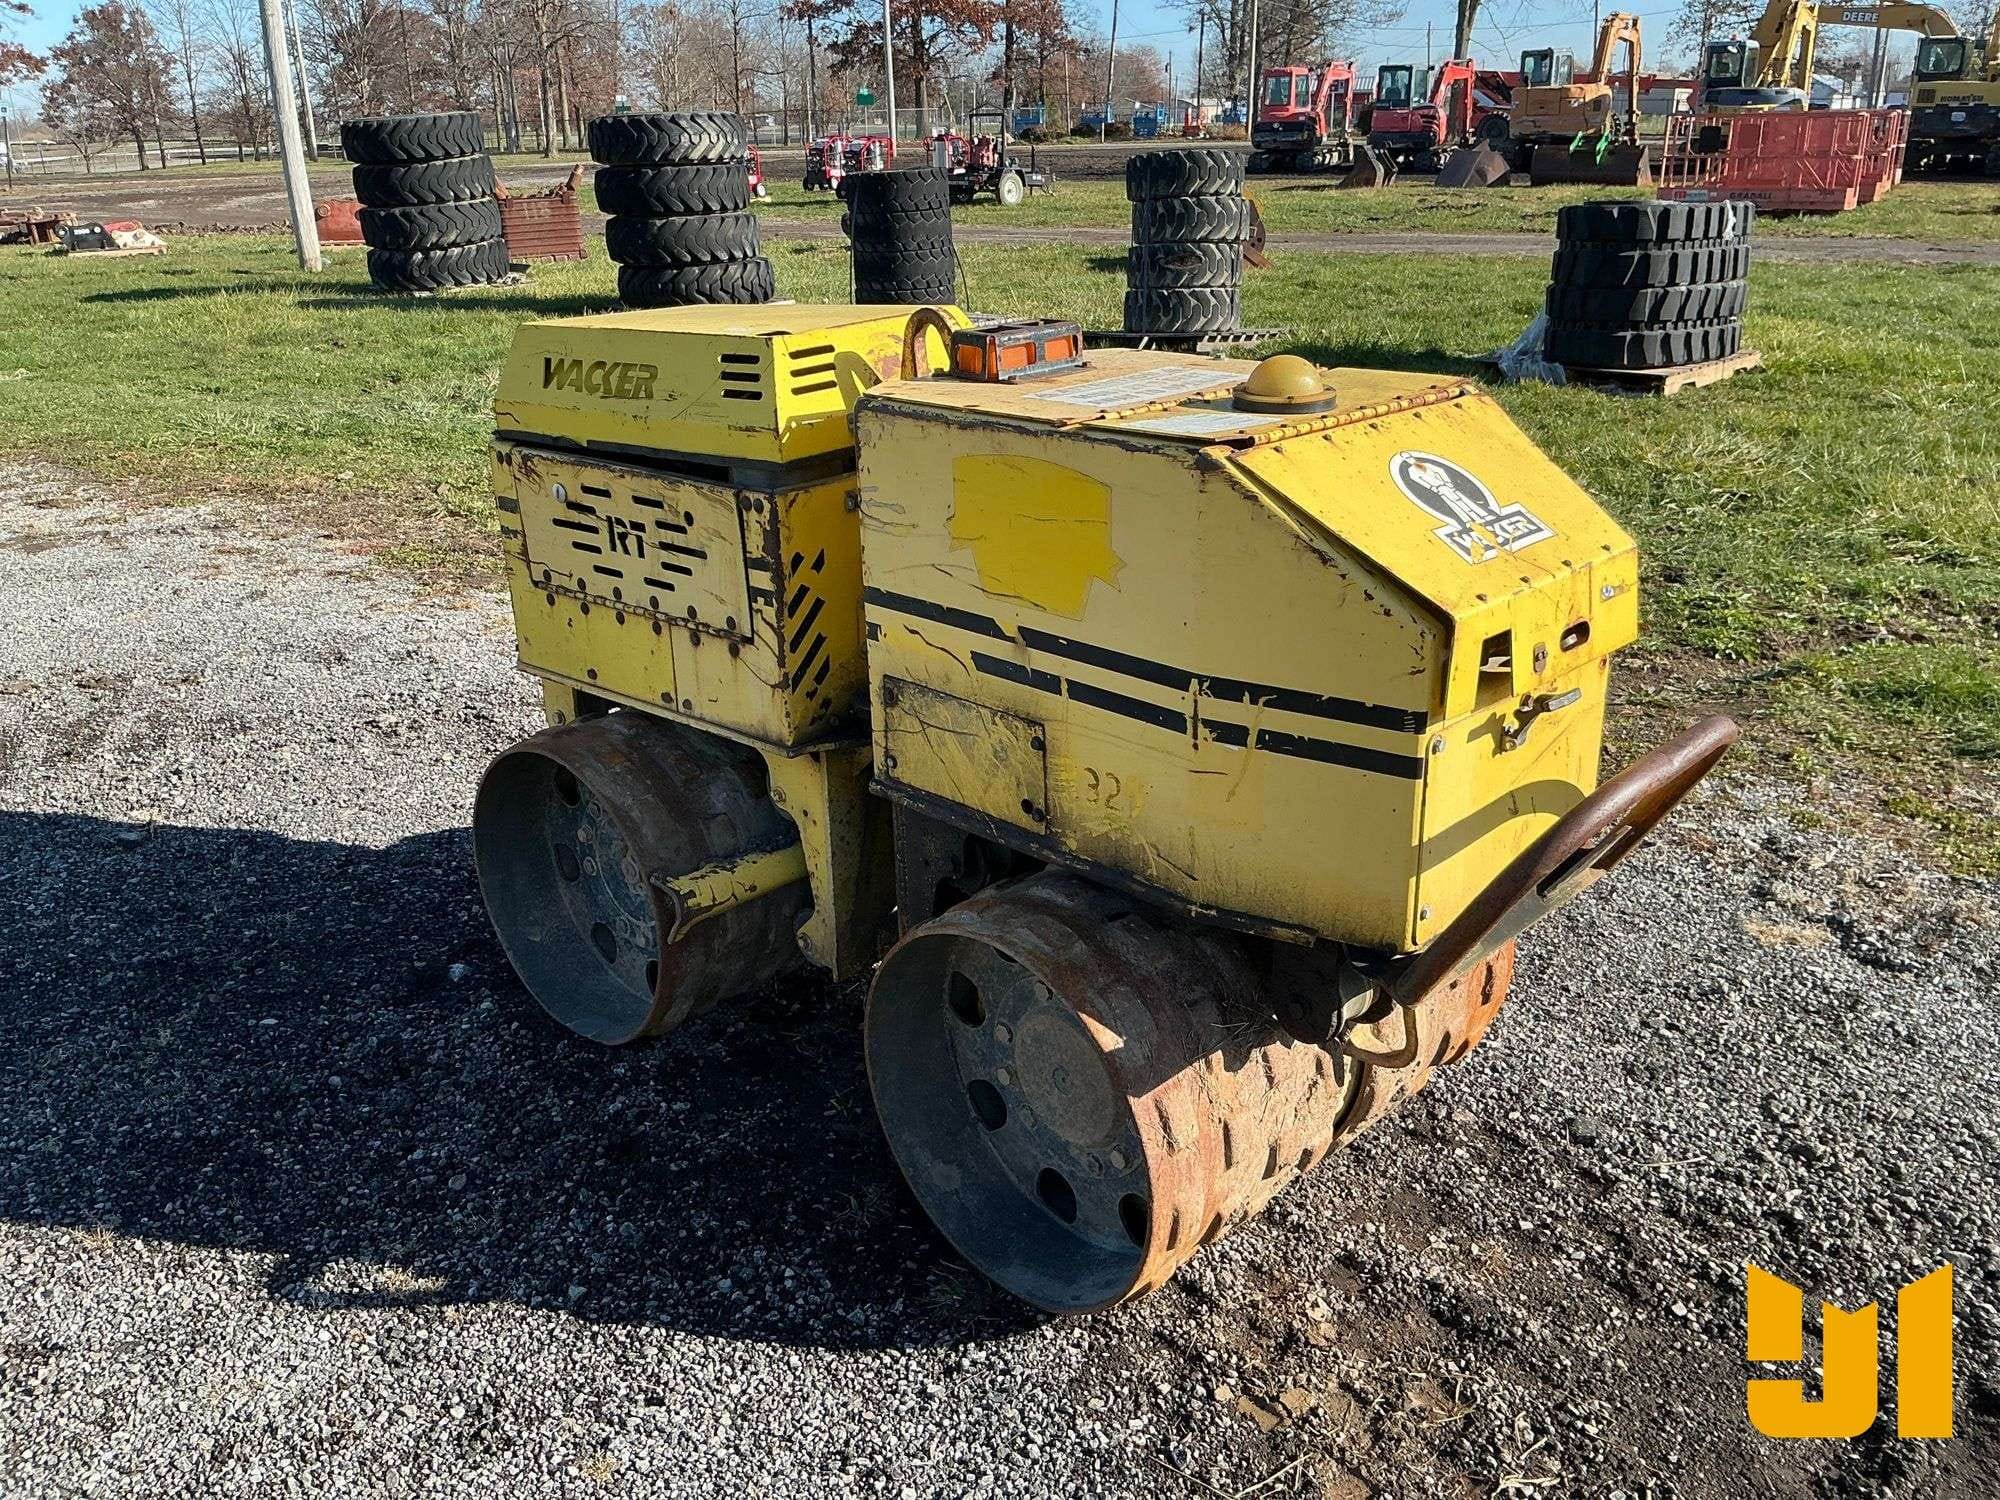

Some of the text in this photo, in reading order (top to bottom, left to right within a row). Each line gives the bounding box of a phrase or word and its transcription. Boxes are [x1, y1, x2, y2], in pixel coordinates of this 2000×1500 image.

[1842, 11, 1879, 23] DEERE
[542, 356, 659, 400] WACKER
[605, 515, 647, 560] RT
